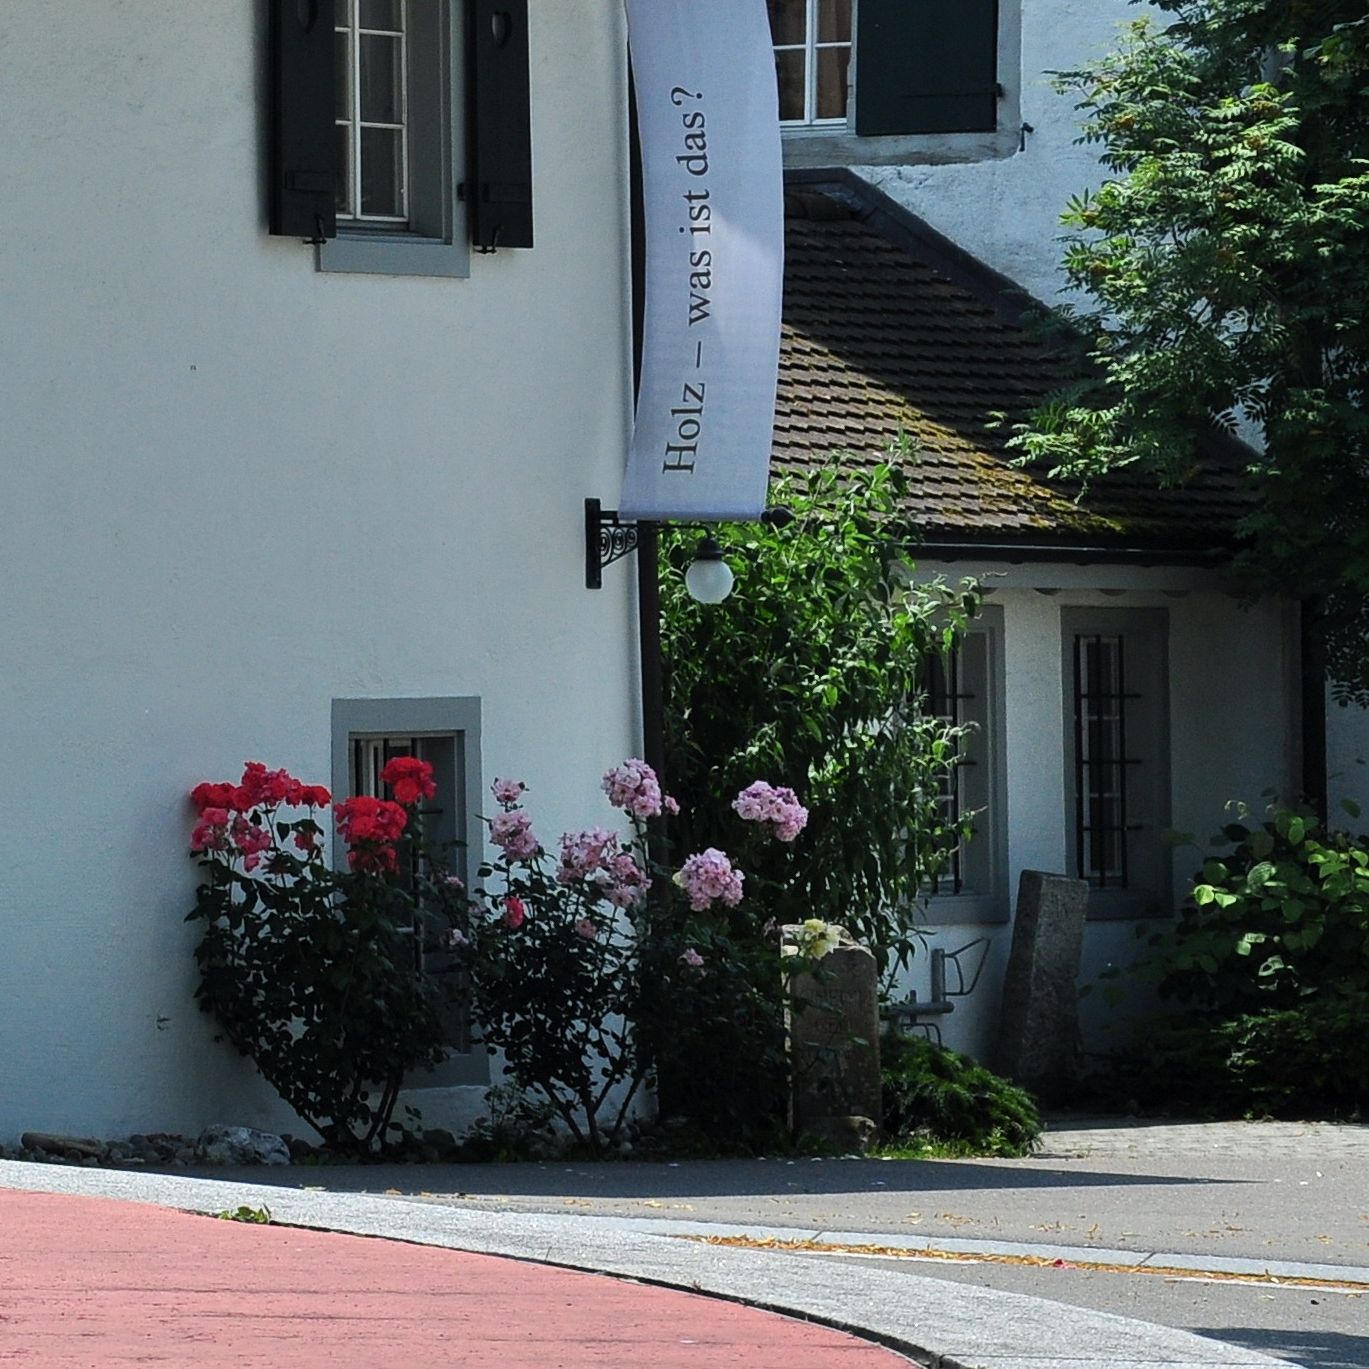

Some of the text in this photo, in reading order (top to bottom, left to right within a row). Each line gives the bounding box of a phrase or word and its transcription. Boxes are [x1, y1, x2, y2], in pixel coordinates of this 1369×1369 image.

[670, 86, 709, 176] das?
[678, 188, 711, 236] ist
[688, 250, 712, 327] was
[661, 382, 706, 475] Holz
